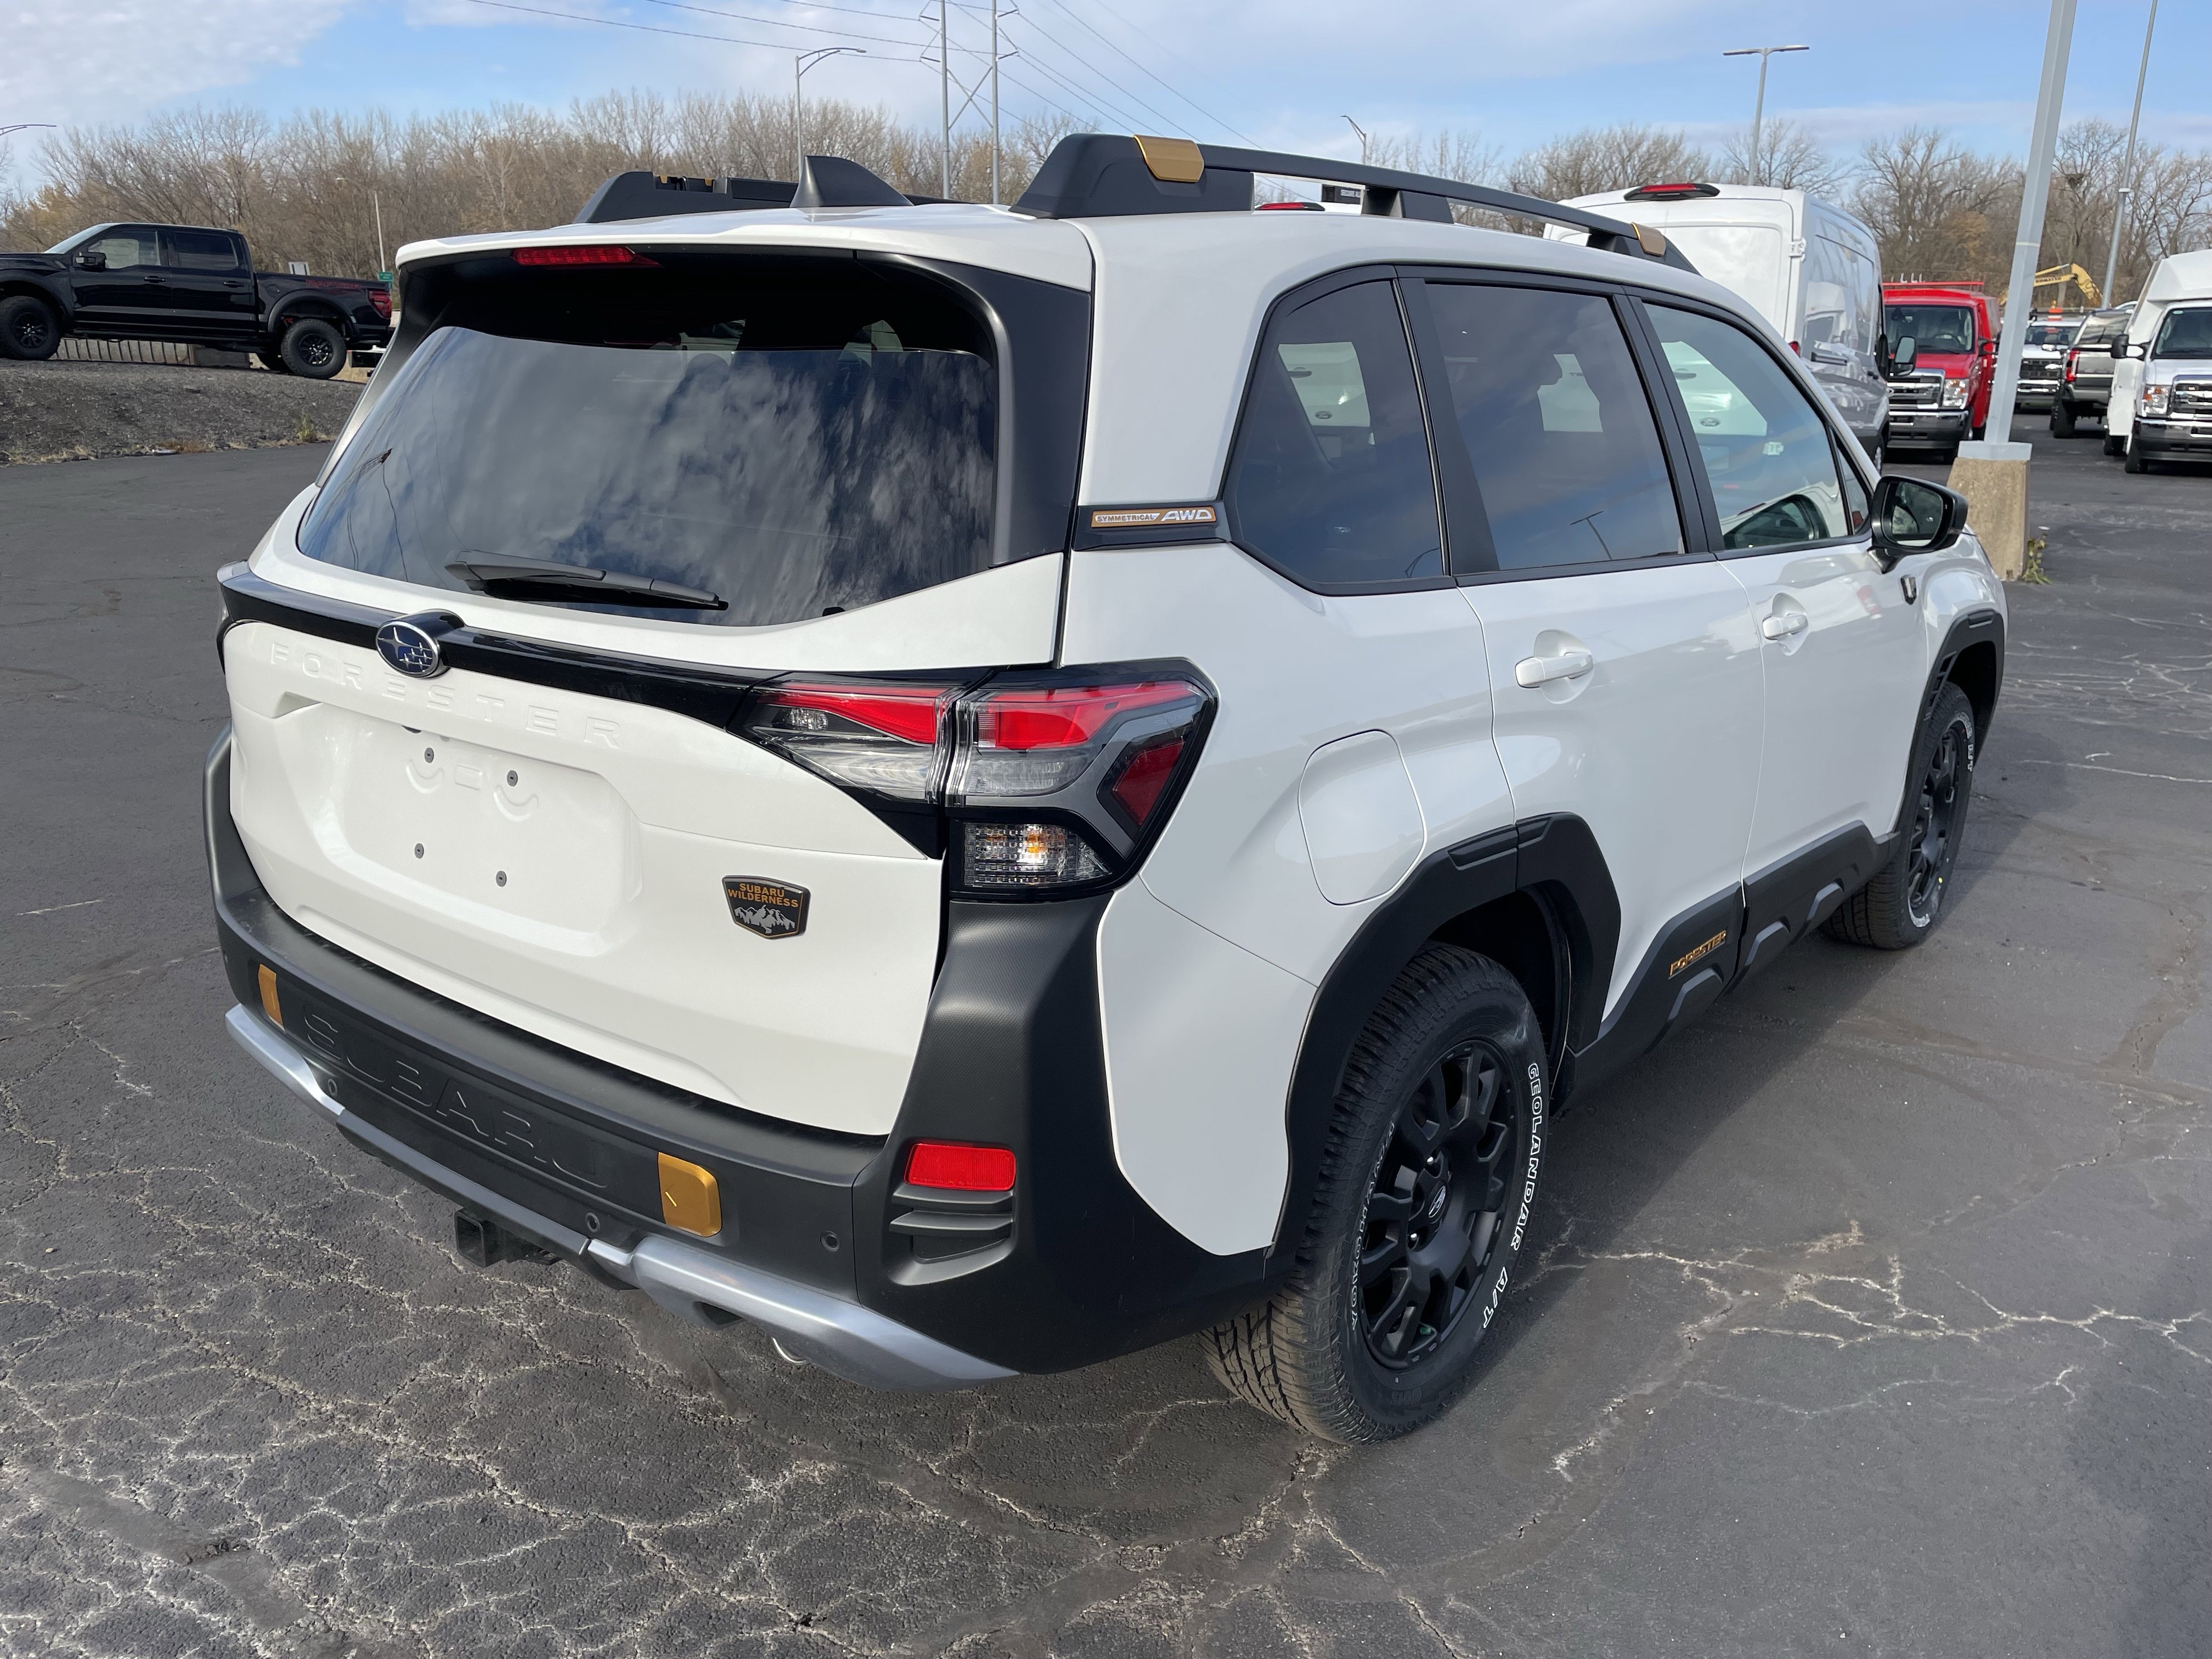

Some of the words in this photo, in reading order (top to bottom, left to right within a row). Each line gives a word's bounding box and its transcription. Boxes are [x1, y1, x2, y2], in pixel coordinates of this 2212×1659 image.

[1097, 514, 1154, 522] SYMMETRICAL
[1160, 509, 1212, 522] AWD
[270, 641, 622, 749] FORESTER
[727, 889, 799, 908] WILDERNESS
[739, 883, 785, 898] SUBARU
[1669, 930, 1727, 976] FORESTER
[303, 1002, 608, 1189] SUBARU
[1510, 1063, 1543, 1251] GEOLANDAR
[1483, 1266, 1508, 1328] A/T
